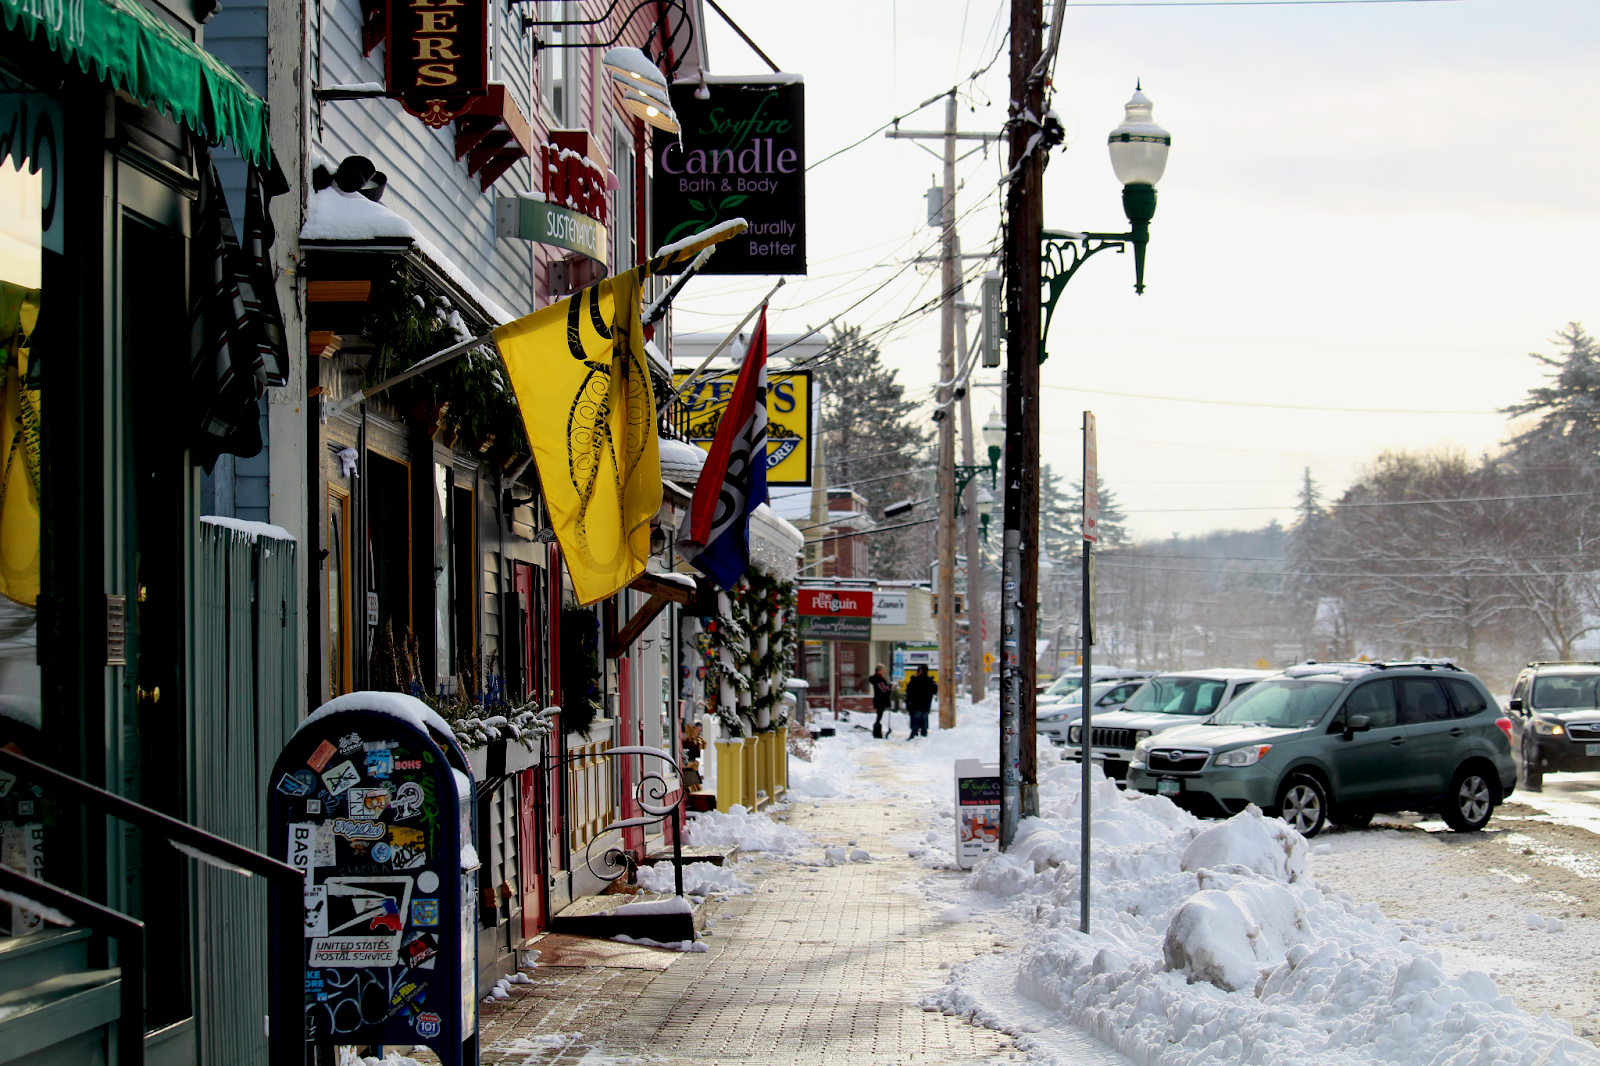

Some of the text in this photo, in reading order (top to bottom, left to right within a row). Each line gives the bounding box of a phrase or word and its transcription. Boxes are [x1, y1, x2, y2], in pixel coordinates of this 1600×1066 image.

[410, 0, 465, 87] ERS
[699, 91, 792, 165] Soyfire
[661, 137, 797, 174] Candle
[680, 178, 778, 195] Bath & Body
[547, 210, 597, 252] SUSTENANCE
[740, 219, 796, 238] aturally
[749, 241, 797, 256] Better
[812, 597, 857, 612] Penguin
[818, 592, 832, 601] the
[316, 942, 390, 950] UNITED STATES
[314, 952, 393, 961] POSTAL SERVICE
[421, 1022, 436, 1032] 101
